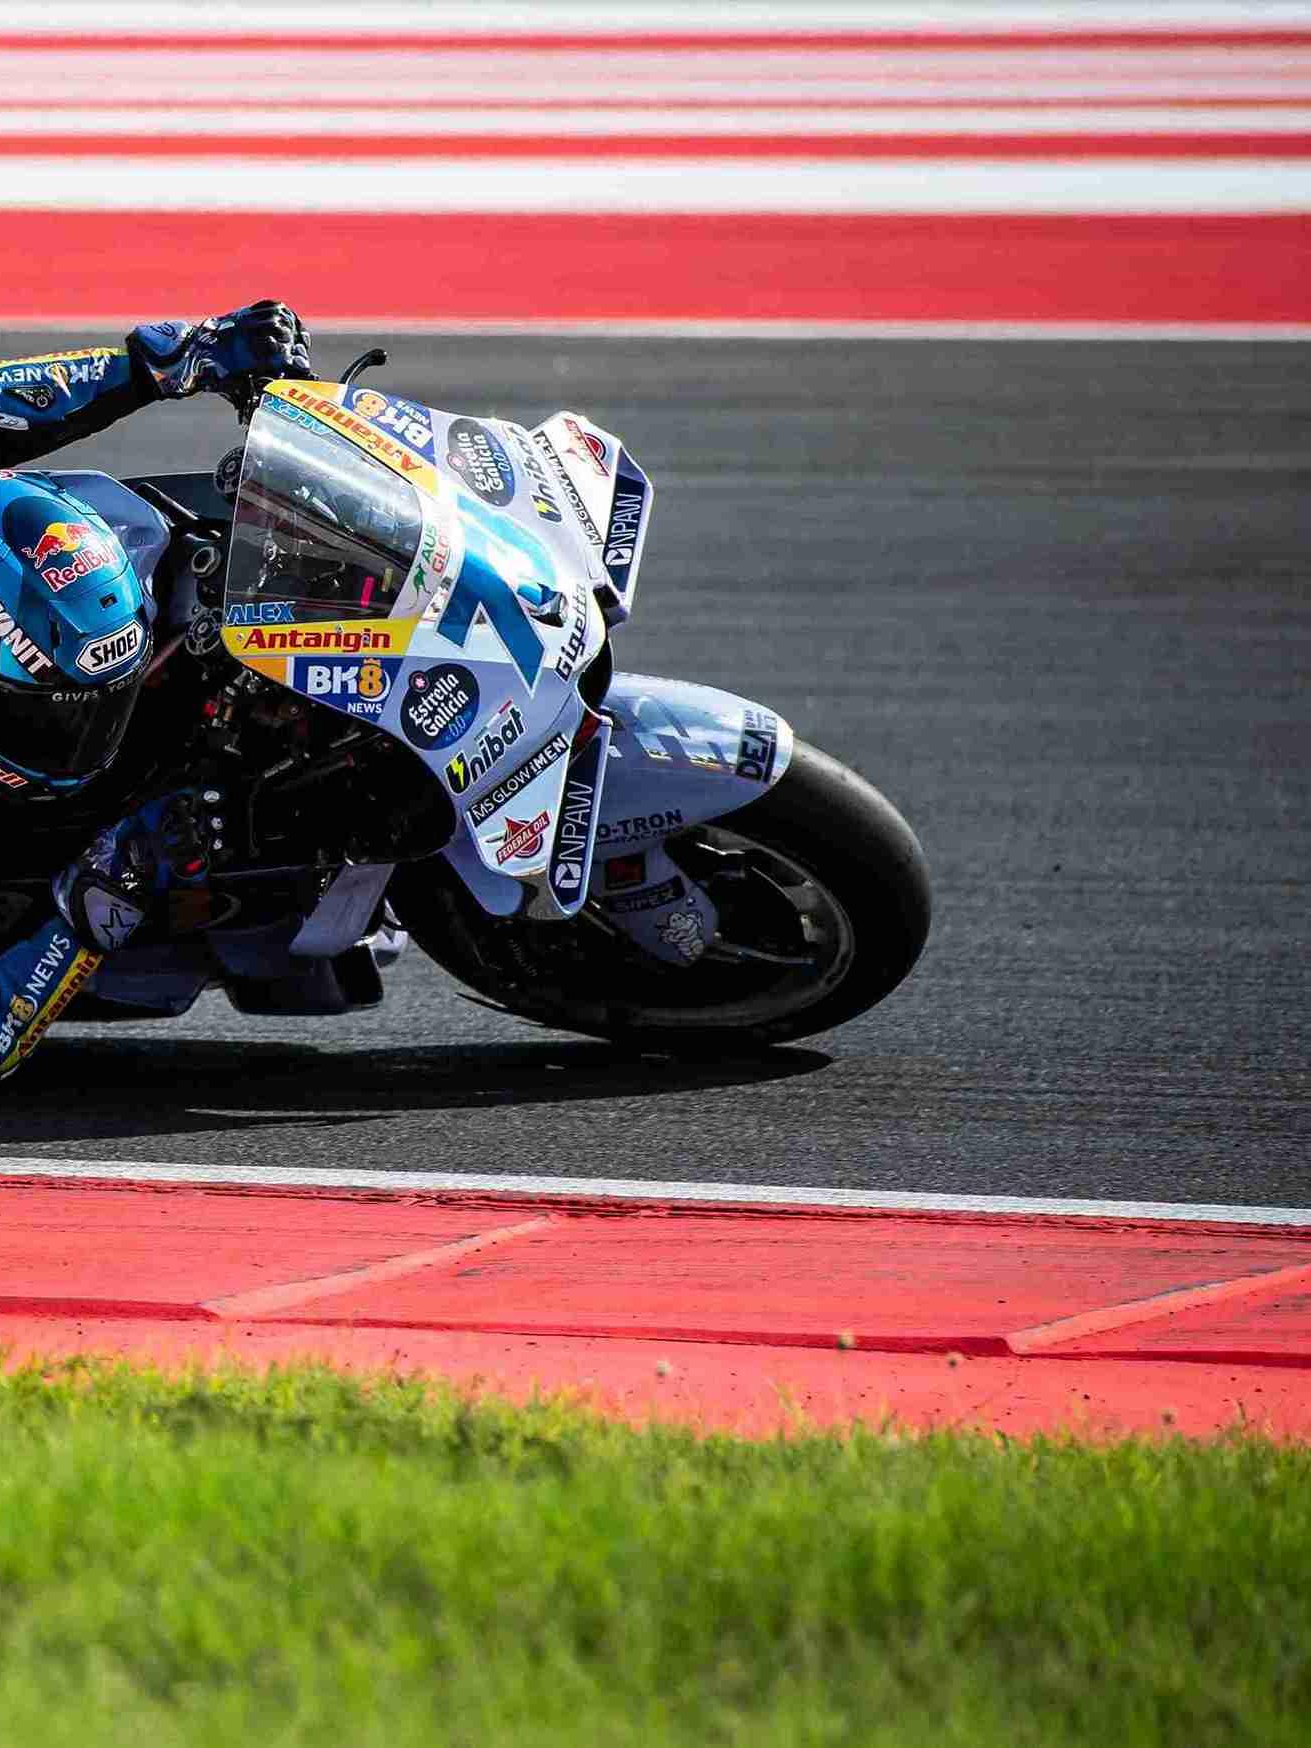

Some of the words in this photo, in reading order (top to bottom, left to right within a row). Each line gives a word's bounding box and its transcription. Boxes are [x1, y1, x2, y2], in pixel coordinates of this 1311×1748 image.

[266, 396, 332, 436] ALEX
[353, 389, 433, 448] BK8
[457, 432, 490, 491] Estrella
[472, 434, 505, 490] Galicia
[615, 493, 642, 549] NPAW
[226, 601, 296, 626] ALEX
[89, 628, 138, 667] SHOEI
[244, 628, 391, 653] Antangin
[307, 657, 391, 702] BK8
[408, 673, 460, 725] Estrella
[347, 703, 383, 714] NEWS
[421, 688, 469, 737] Galicia
[445, 704, 528, 795] Unibat
[471, 799, 495, 823] MS
[491, 767, 531, 805] GLOW
[558, 780, 594, 860] NPAW
[498, 829, 533, 863] FEDERAL
[533, 813, 550, 833] OIL
[26, 934, 71, 994] NEWS
